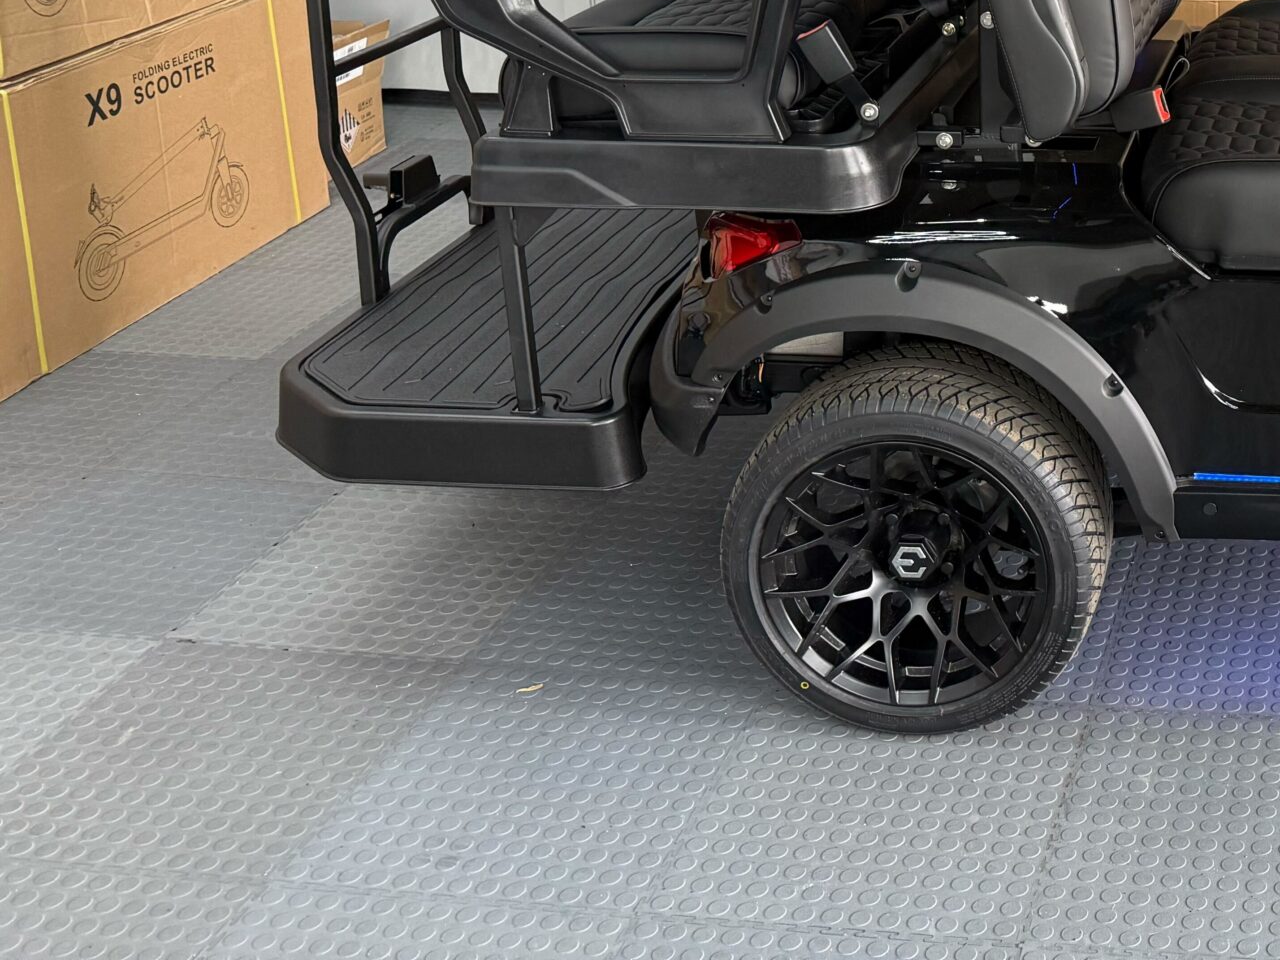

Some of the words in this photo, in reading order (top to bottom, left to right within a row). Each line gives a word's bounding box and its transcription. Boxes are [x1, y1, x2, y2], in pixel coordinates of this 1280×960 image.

[132, 60, 171, 83] FOLDING
[172, 43, 214, 68] ELECTRIC
[133, 56, 216, 105] SCOOTER
[84, 82, 122, 127] X9
